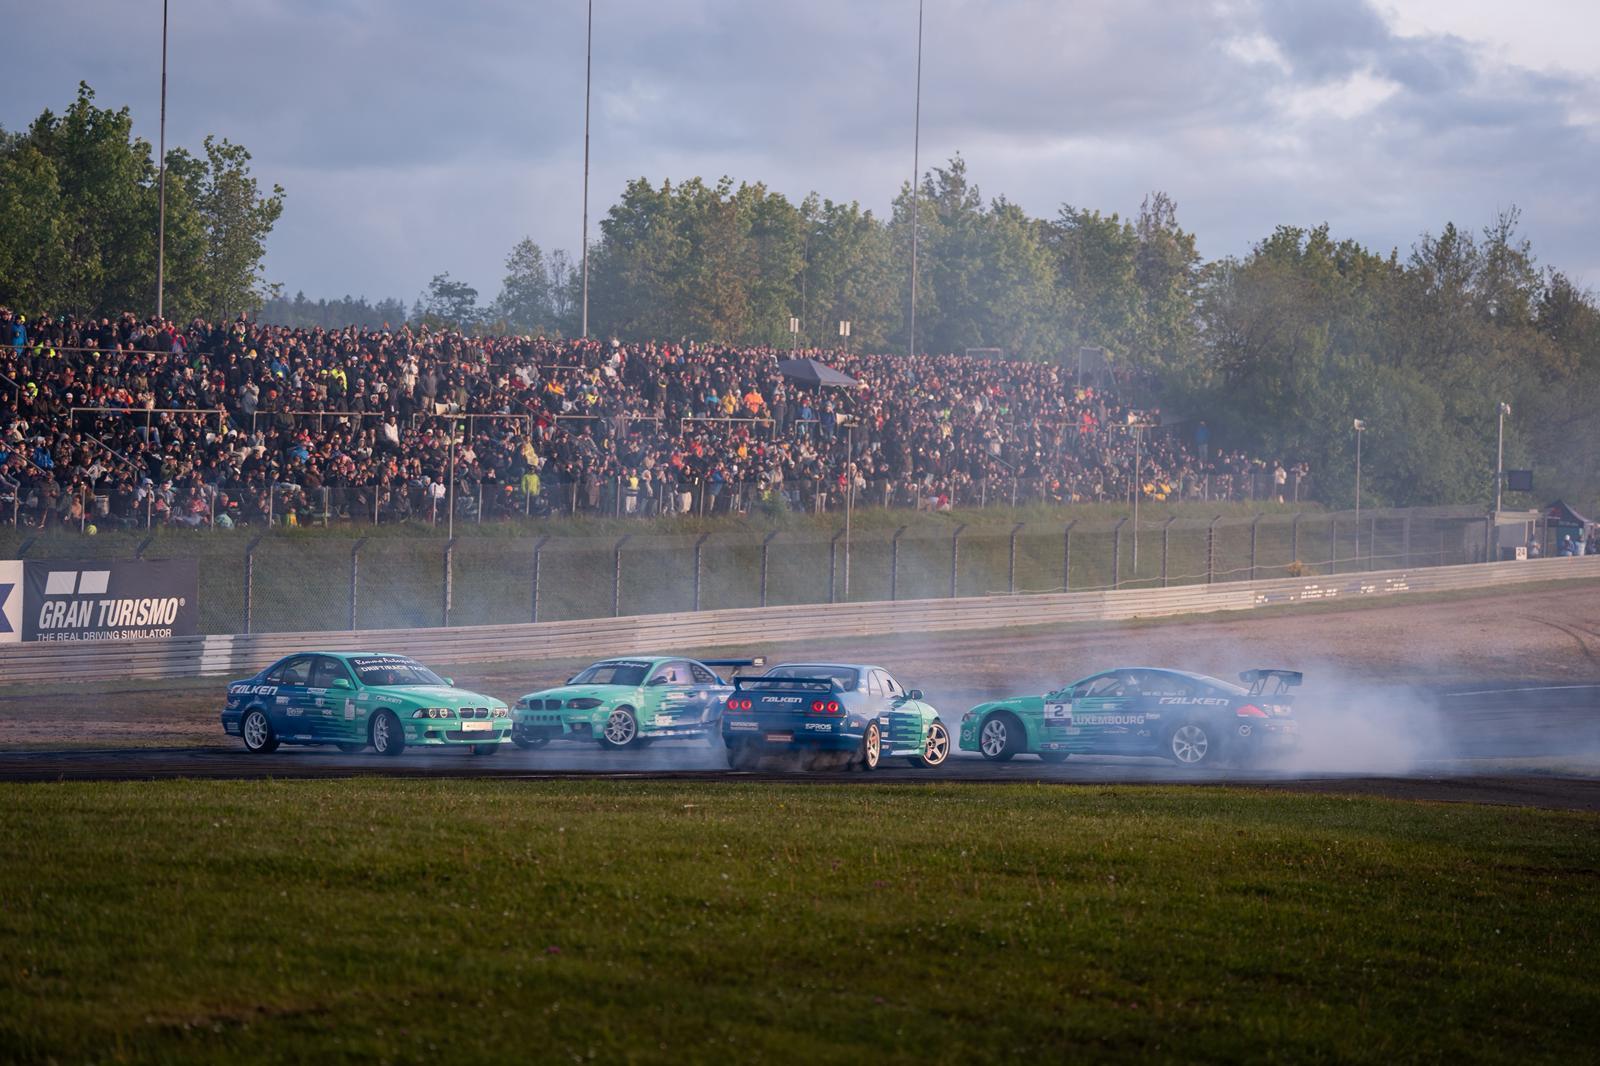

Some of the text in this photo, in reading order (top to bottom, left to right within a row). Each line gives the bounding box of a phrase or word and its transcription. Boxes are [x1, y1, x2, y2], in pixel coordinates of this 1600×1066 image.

[39, 601, 92, 629] GRAN
[37, 628, 172, 641] THE REAL DRIVING SIMULATOR
[230, 684, 279, 696] FALKEN
[1158, 697, 1229, 706] FALKEN
[1054, 705, 1064, 717] 2
[1072, 713, 1145, 725] LUXEMBOURG
